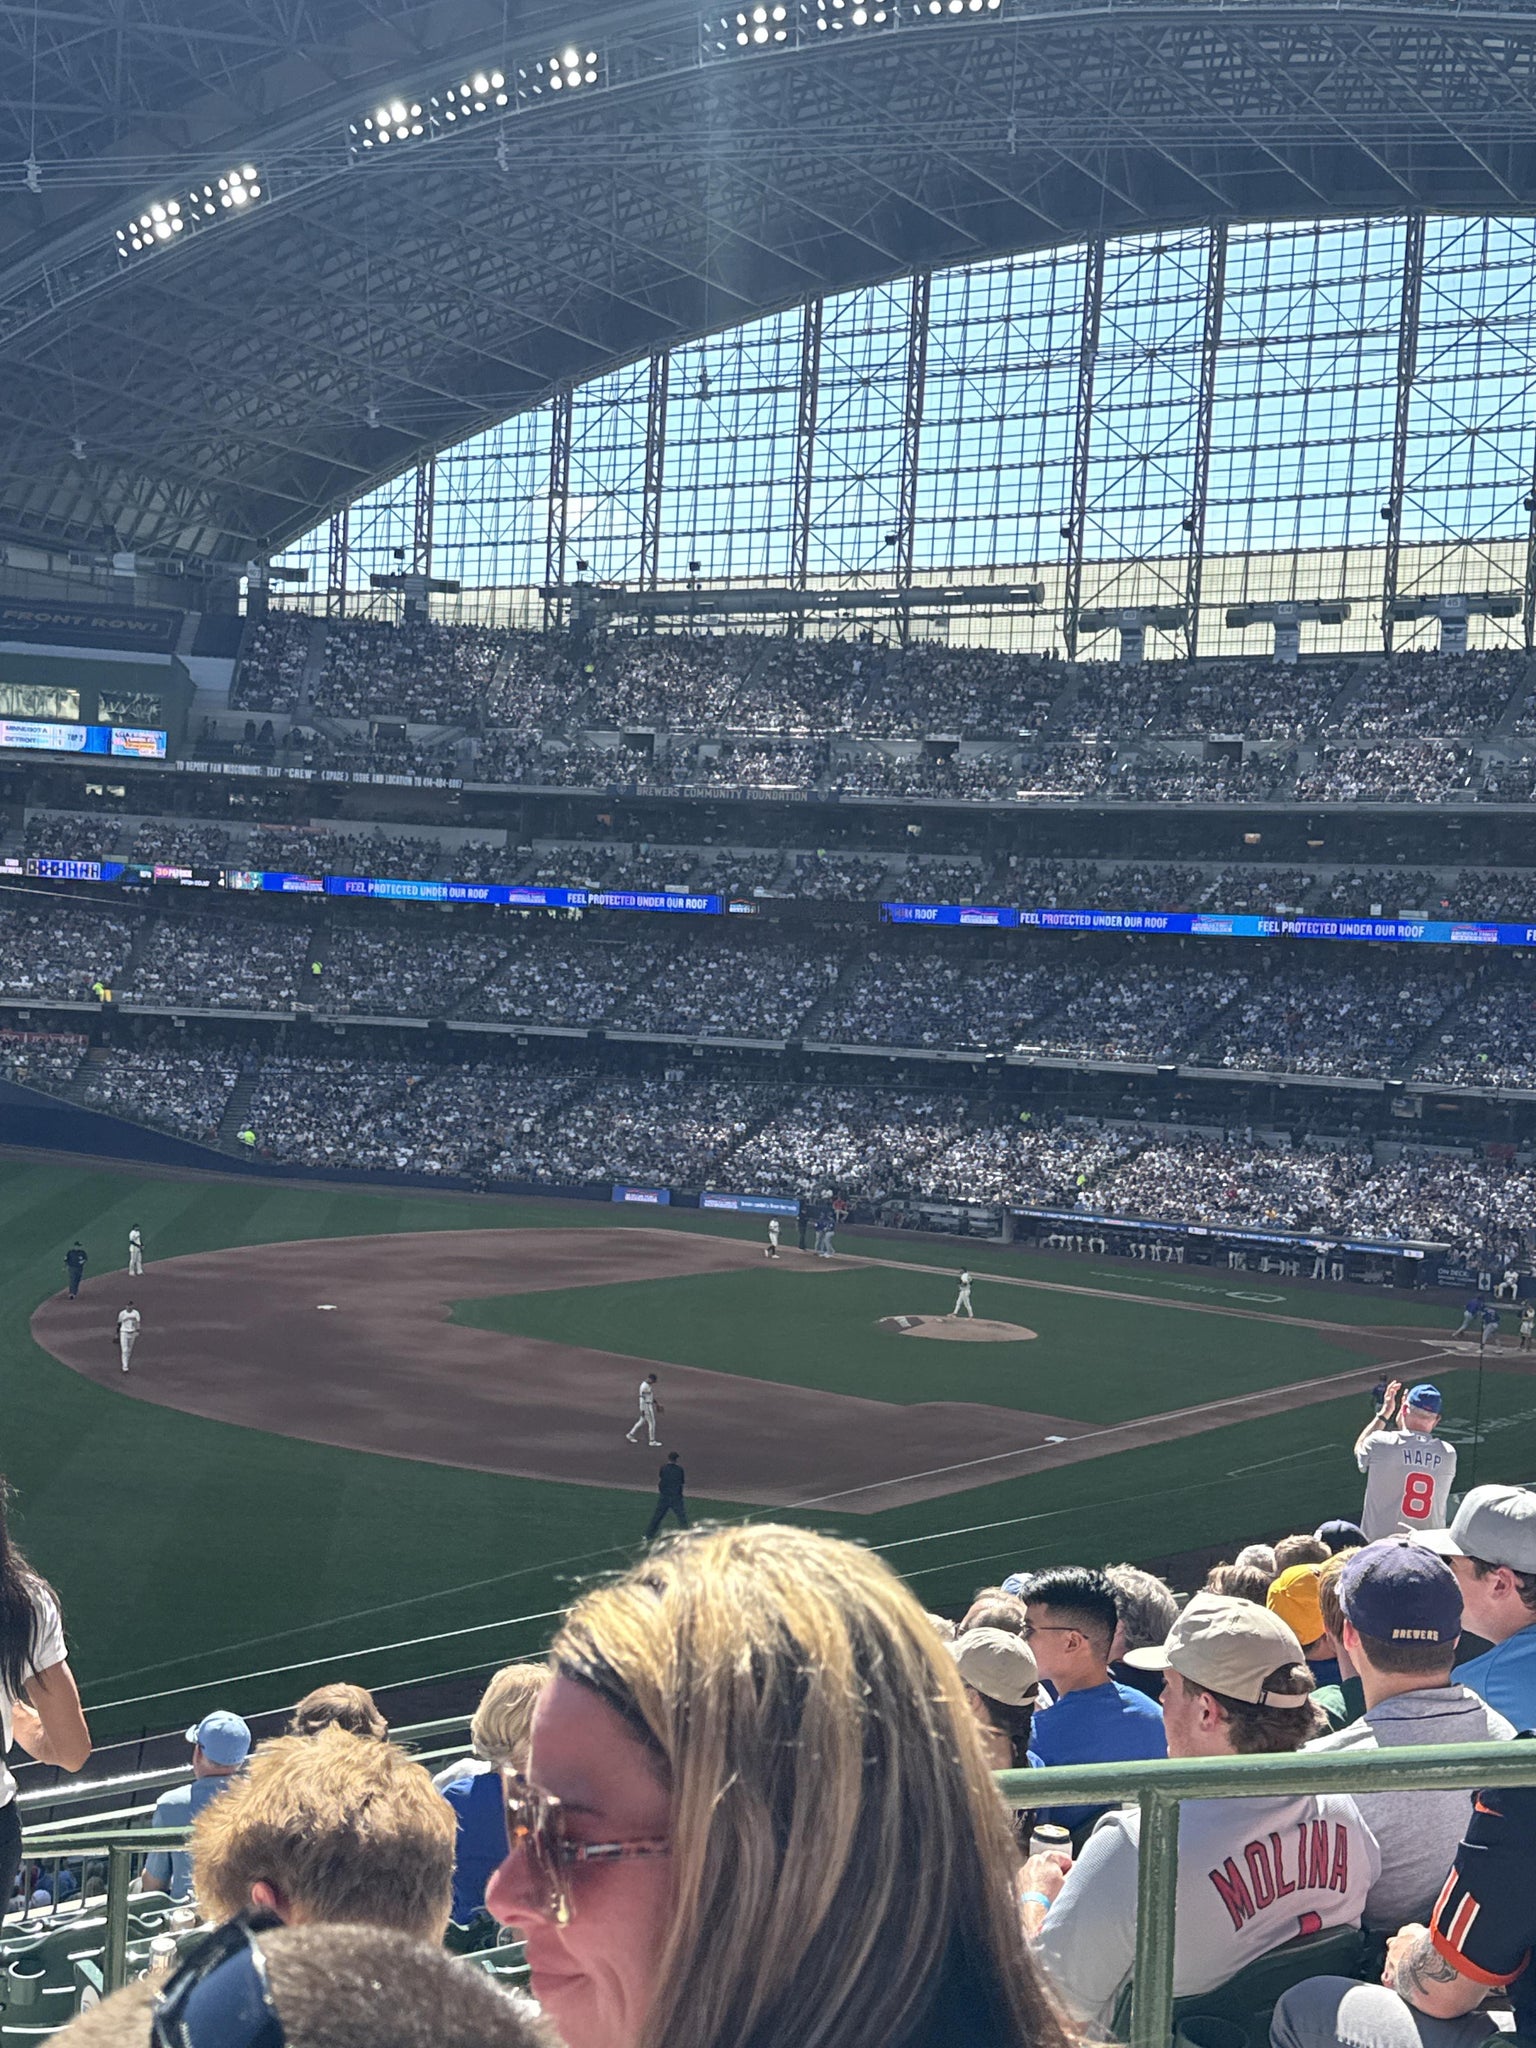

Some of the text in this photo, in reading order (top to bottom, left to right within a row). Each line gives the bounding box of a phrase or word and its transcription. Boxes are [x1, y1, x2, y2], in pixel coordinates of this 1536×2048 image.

[3, 610, 87, 625] FRONT
[4, 735, 36, 744] DETROIT
[176, 760, 184, 771] TO
[186, 761, 208, 772] REPORT
[210, 763, 221, 773] FAN
[353, 772, 370, 783] ISSUE
[372, 773, 384, 784] AND
[385, 775, 413, 786] LOCATION
[636, 786, 808, 801] BREWERS COMMUNITY FOUNDATION
[345, 881, 489, 899] FEEL PROTECTED UNDER OUR ROOF
[567, 893, 707, 909] FEEL PROTECTED UNDER OUR ROOF
[914, 908, 938, 920] ROOF
[1020, 913, 1168, 928] FEEL PROTECTED UNDER OUR ROOF
[1257, 921, 1425, 938] FEEL PROTECTED UNDER OUR ROOF
[1403, 1449, 1442, 1469] HAPP
[1401, 1471, 1435, 1520] 8
[1391, 1628, 1439, 1641] BREWERS
[1208, 1819, 1348, 1933] MOLINA
